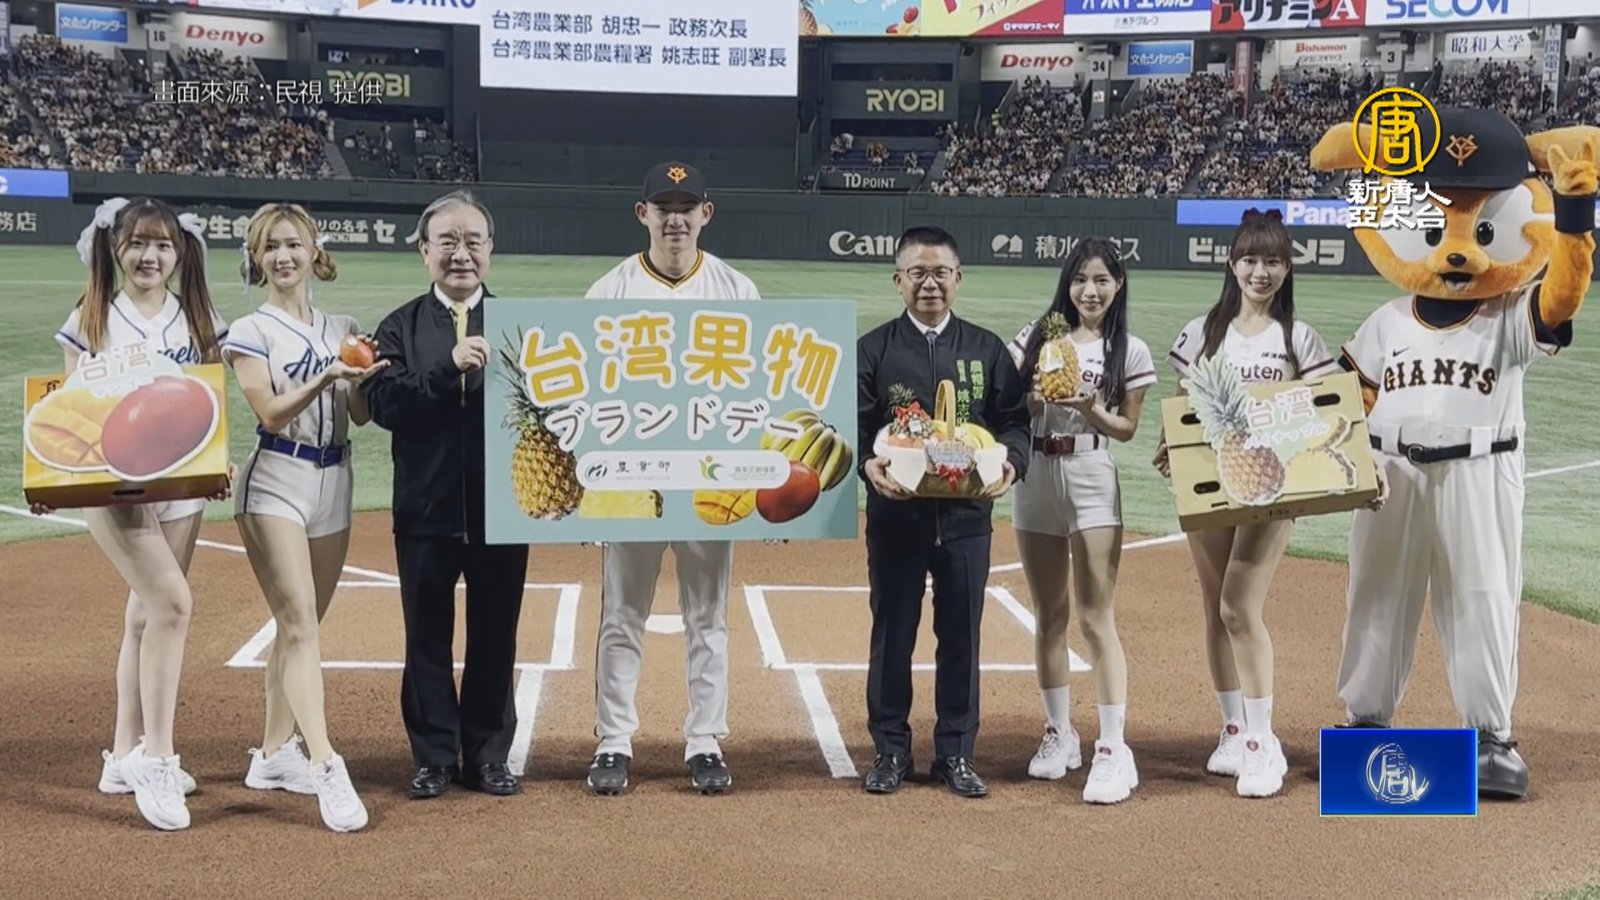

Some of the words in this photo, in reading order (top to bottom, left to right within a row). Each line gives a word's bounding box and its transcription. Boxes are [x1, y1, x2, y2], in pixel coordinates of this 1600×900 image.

[152, 30, 166, 43] 16
[185, 24, 265, 46] Denyo
[491, 9, 593, 34] 台湾農業部
[601, 15, 661, 35] 胡忠一
[668, 17, 748, 39] 政務次長
[491, 38, 652, 64] 台湾農業部農糧署
[661, 45, 721, 66] 姚志旺
[728, 47, 787, 67] 副署長
[1386, 51, 1395, 63] 3
[1451, 35, 1525, 54] 昭和大学
[1000, 53, 1074, 71] Denyo
[1092, 61, 1105, 73] 34
[866, 88, 945, 112] RYOBI
[828, 230, 902, 256] Can
[520, 312, 840, 409] 台湾果物
[1383, 357, 1497, 396] GIANTS
[1249, 388, 1314, 428] 台湾
[548, 400, 801, 448] ブランドデー
